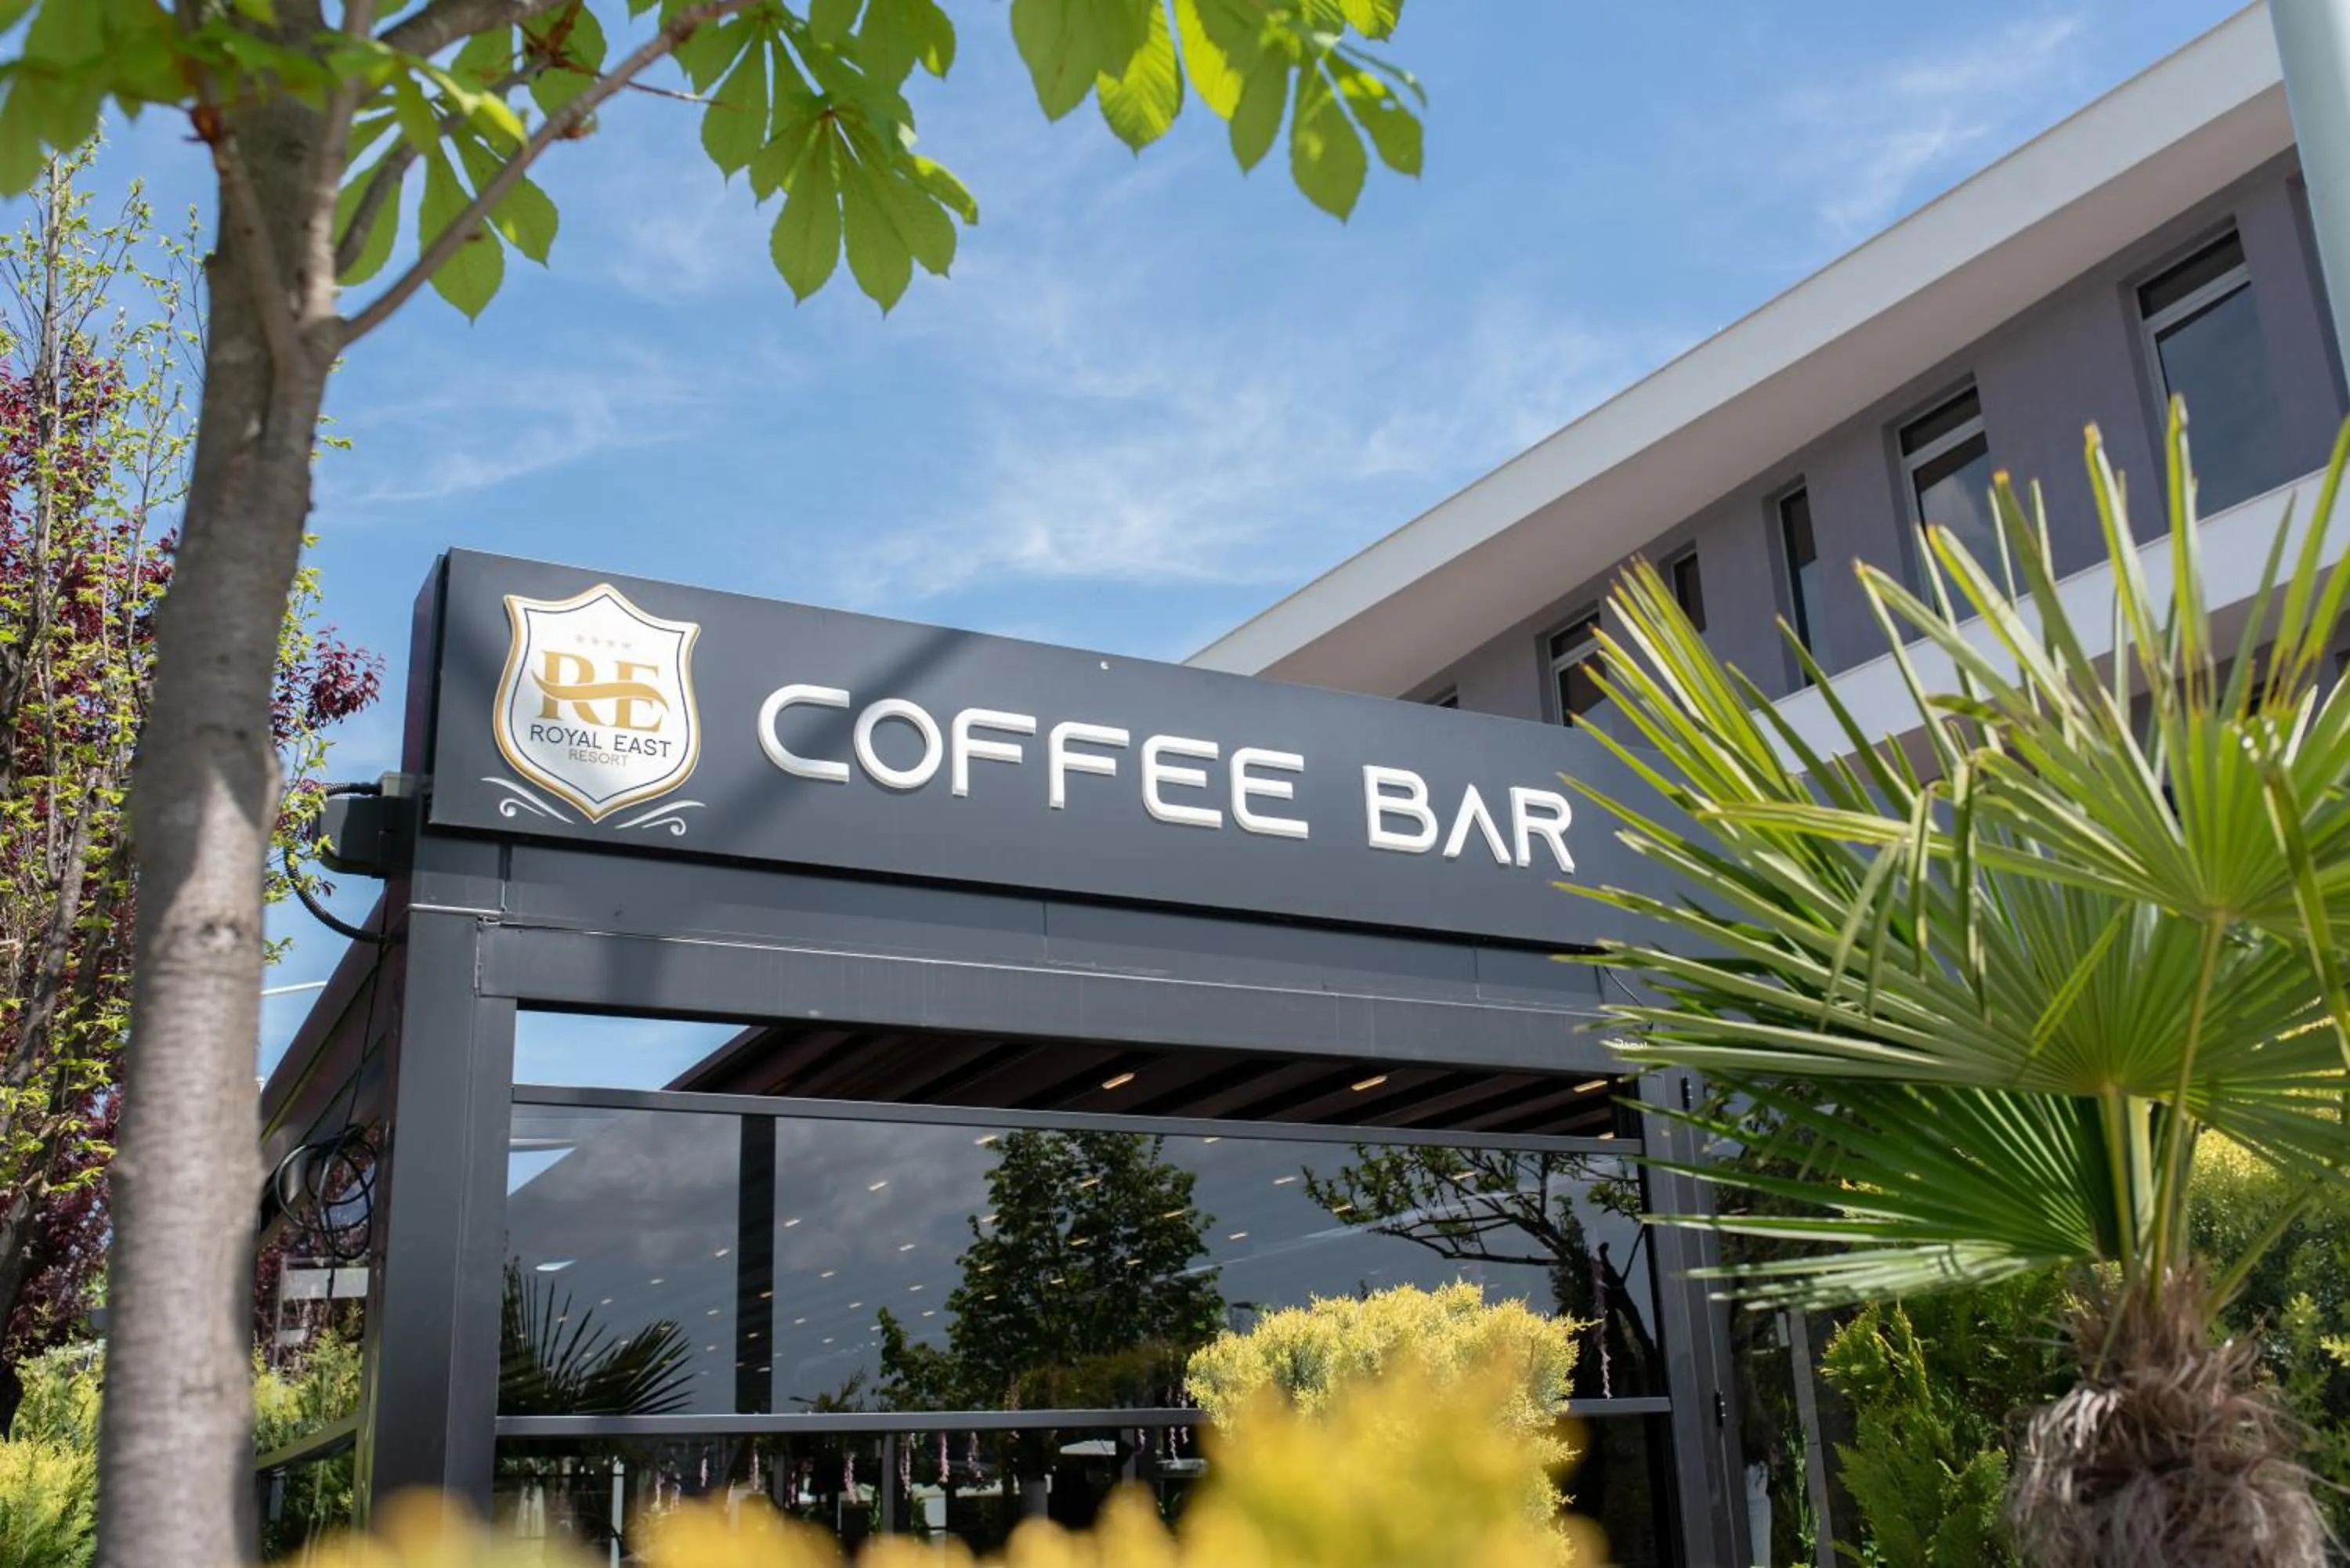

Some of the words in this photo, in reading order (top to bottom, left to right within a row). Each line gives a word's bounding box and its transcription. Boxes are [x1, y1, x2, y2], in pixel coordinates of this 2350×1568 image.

[533, 650, 669, 732] RE
[531, 724, 602, 750] ROYAL
[615, 734, 671, 757] EAST
[569, 750, 628, 766] RESORT
[757, 683, 1309, 839] COFFEE
[1364, 764, 1575, 873] BAR
